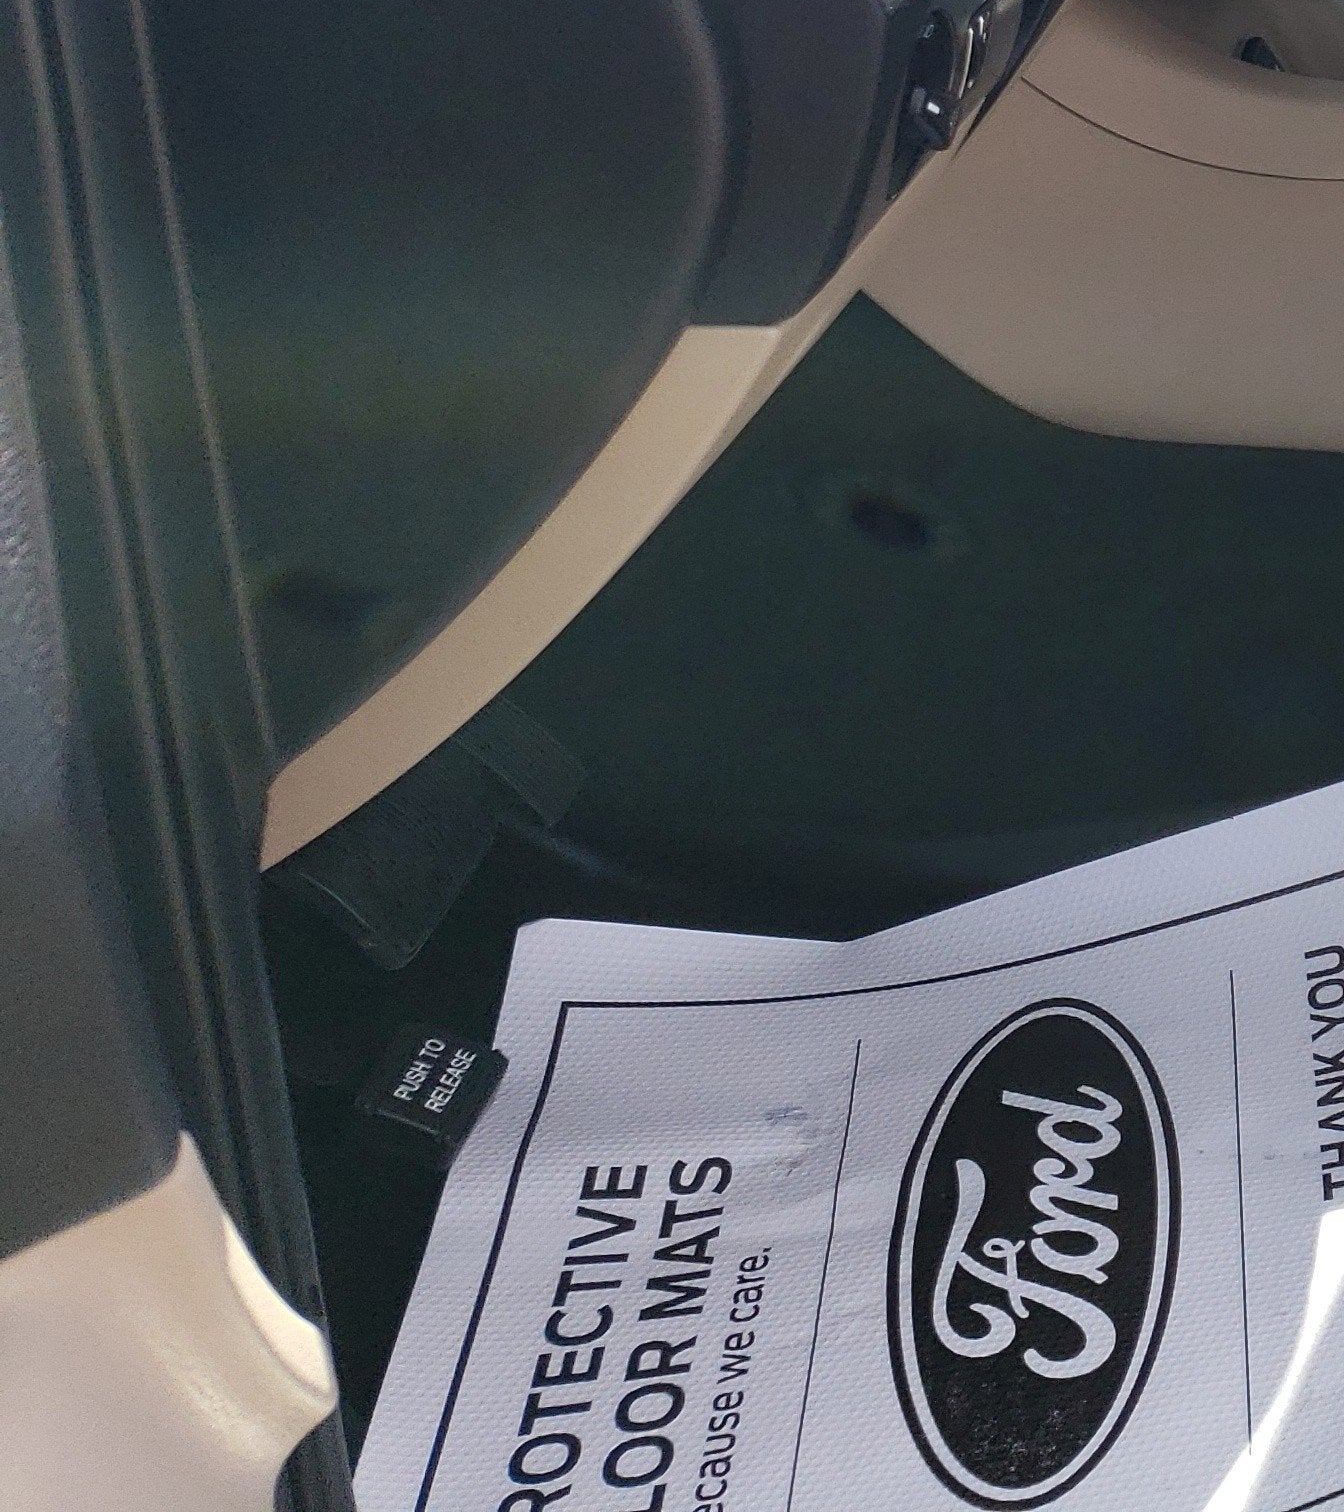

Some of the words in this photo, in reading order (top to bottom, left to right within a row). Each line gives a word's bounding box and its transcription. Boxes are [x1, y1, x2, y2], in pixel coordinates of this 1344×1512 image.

[392, 1060, 435, 1101] PUSH
[419, 1038, 446, 1059] TO
[424, 1048, 477, 1114] RELEASE
[638, 1156, 733, 1323] MATS
[932, 1084, 1124, 1379] Ford
[730, 1246, 772, 1323] care.
[717, 1331, 756, 1385] we
